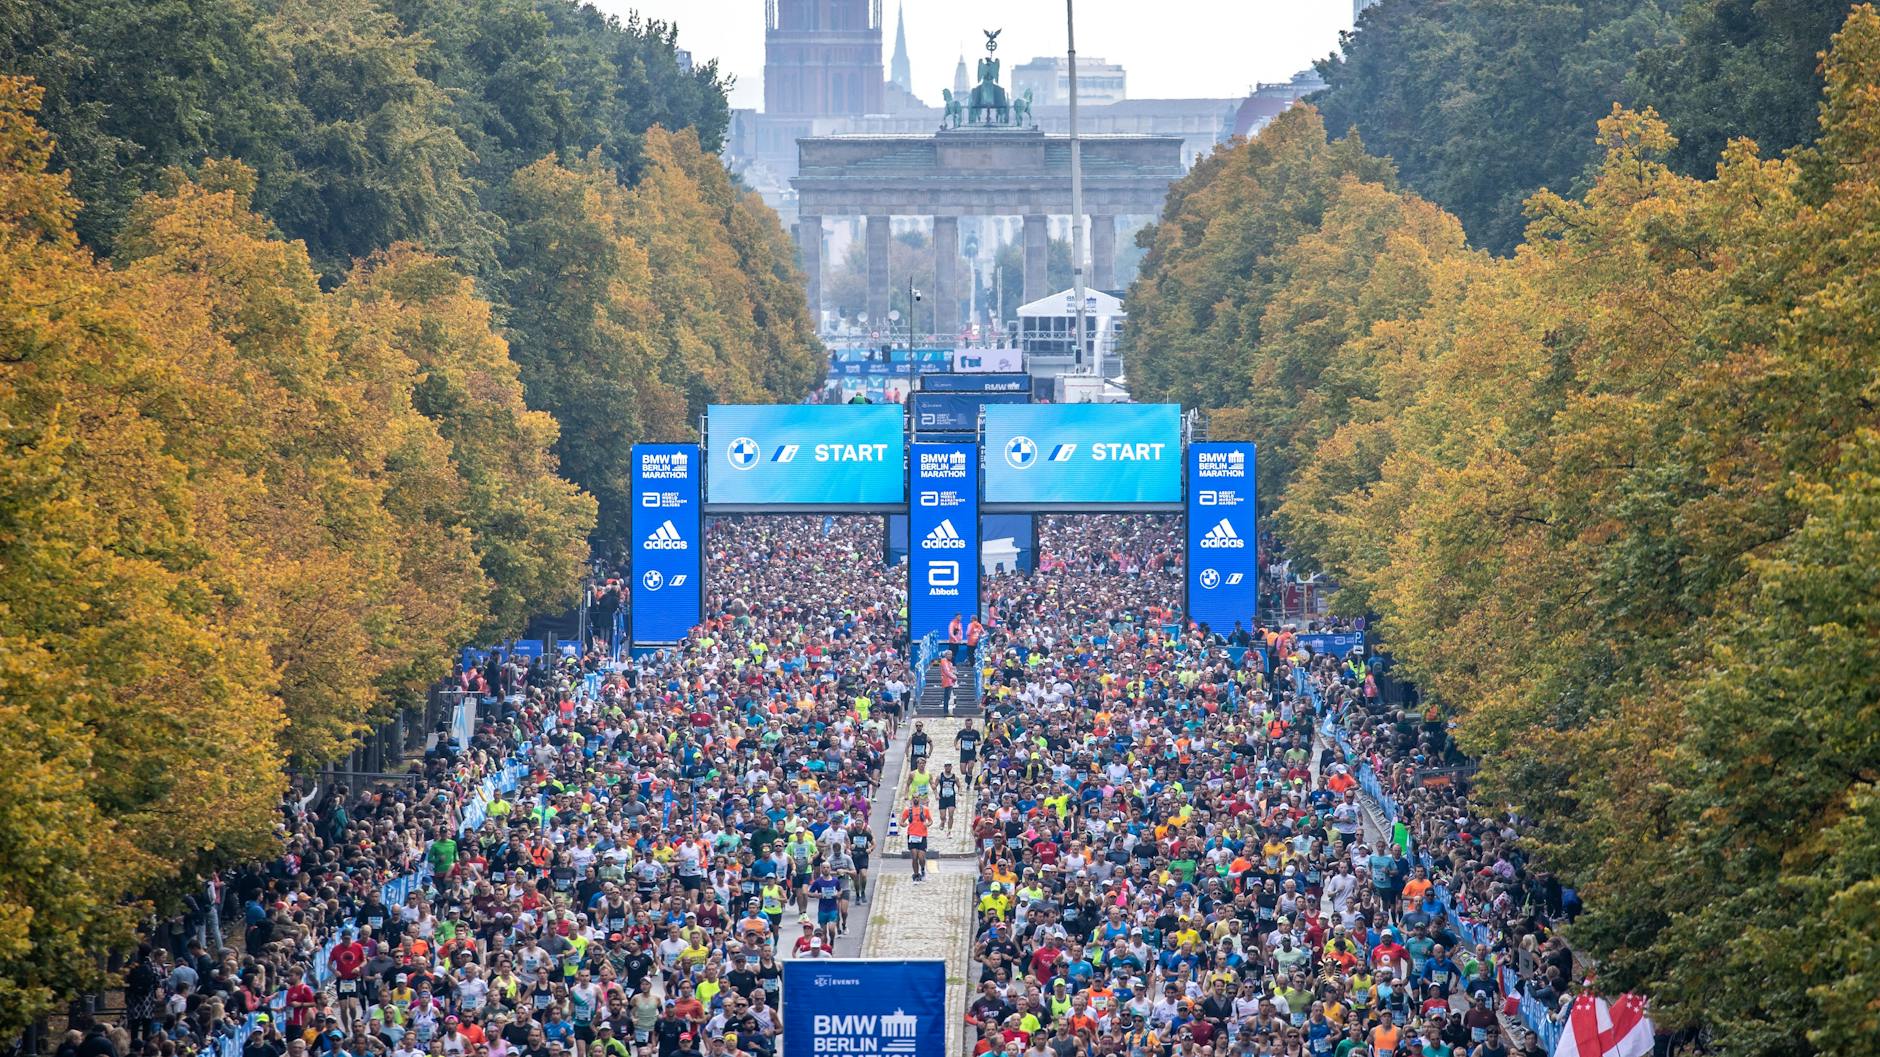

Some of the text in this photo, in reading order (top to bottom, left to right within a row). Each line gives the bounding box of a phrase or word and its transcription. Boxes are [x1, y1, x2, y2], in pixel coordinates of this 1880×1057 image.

[815, 443, 888, 462] START
[1092, 443, 1165, 461] START
[1199, 453, 1227, 462] BMW
[642, 454, 670, 464] BMW
[920, 454, 948, 463] BMW
[642, 471, 687, 479] MARATHON
[643, 538, 688, 550] adidas
[922, 538, 966, 548] adidas
[1200, 536, 1244, 548] adidas
[1356, 632, 1362, 644] P
[814, 1015, 877, 1035] BMW
[814, 1037, 878, 1052] BERLIN
